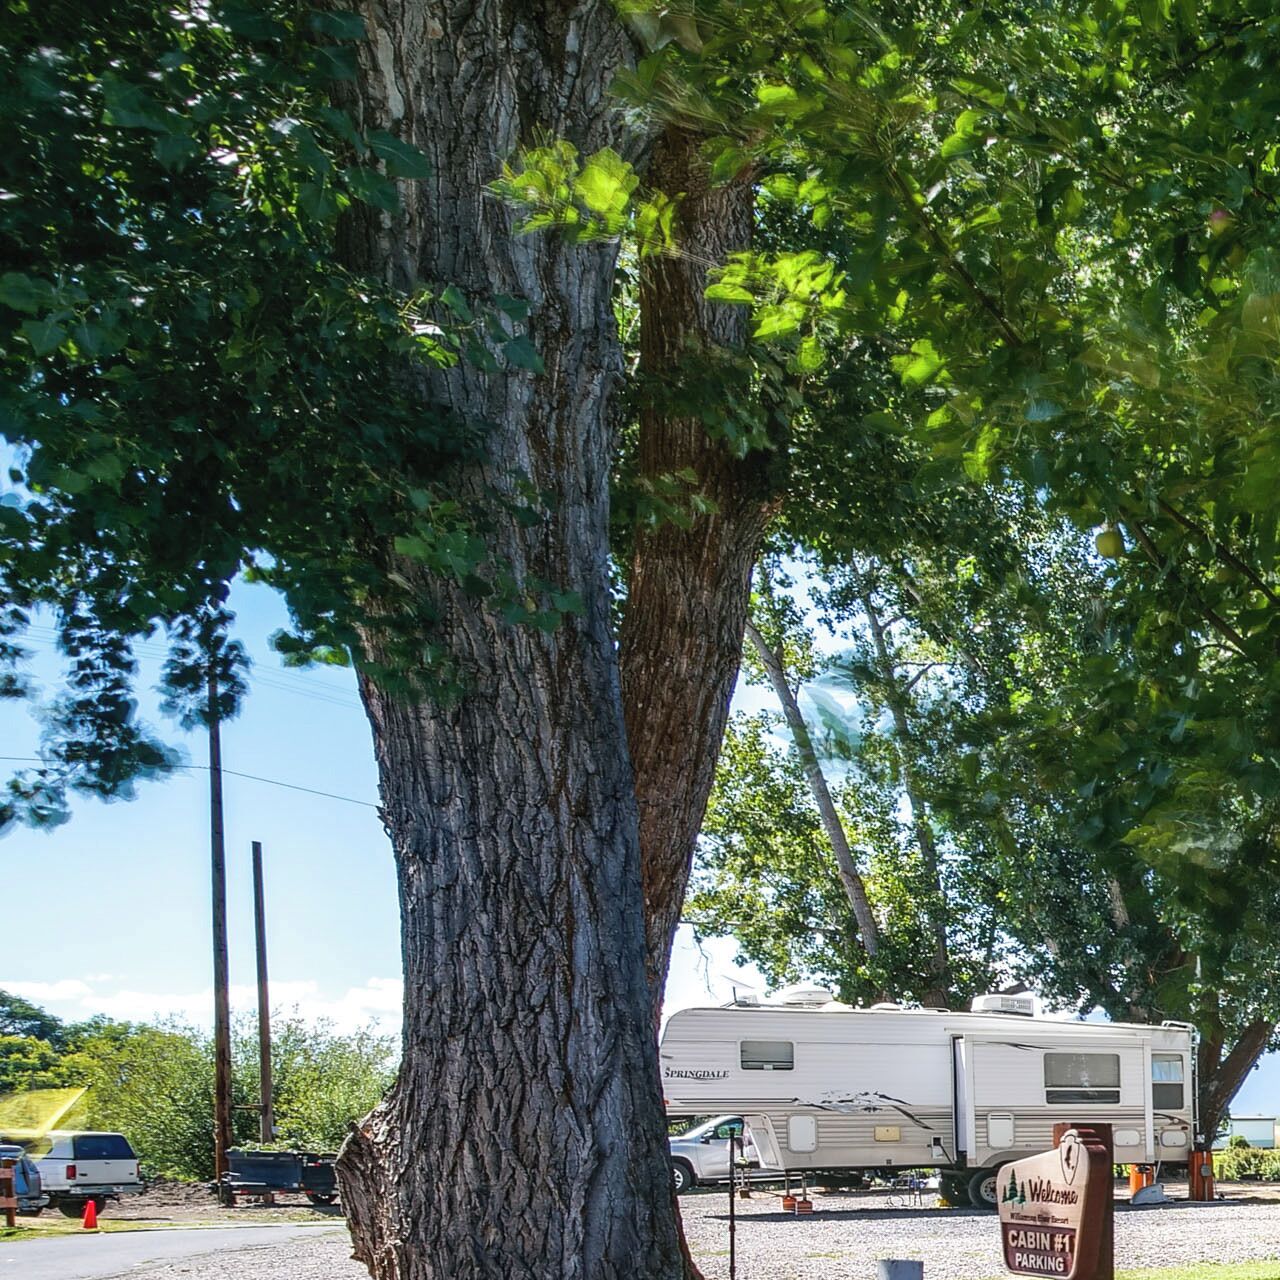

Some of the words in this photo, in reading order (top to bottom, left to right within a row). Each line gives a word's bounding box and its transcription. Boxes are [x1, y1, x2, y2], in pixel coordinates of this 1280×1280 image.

[664, 1068, 730, 1079] SPRINGDALE
[1028, 1178, 1078, 1205] Welcome
[1008, 1229, 1050, 1250] CABIN
[1053, 1233, 1070, 1252] #1
[1015, 1252, 1065, 1272] PARKING
